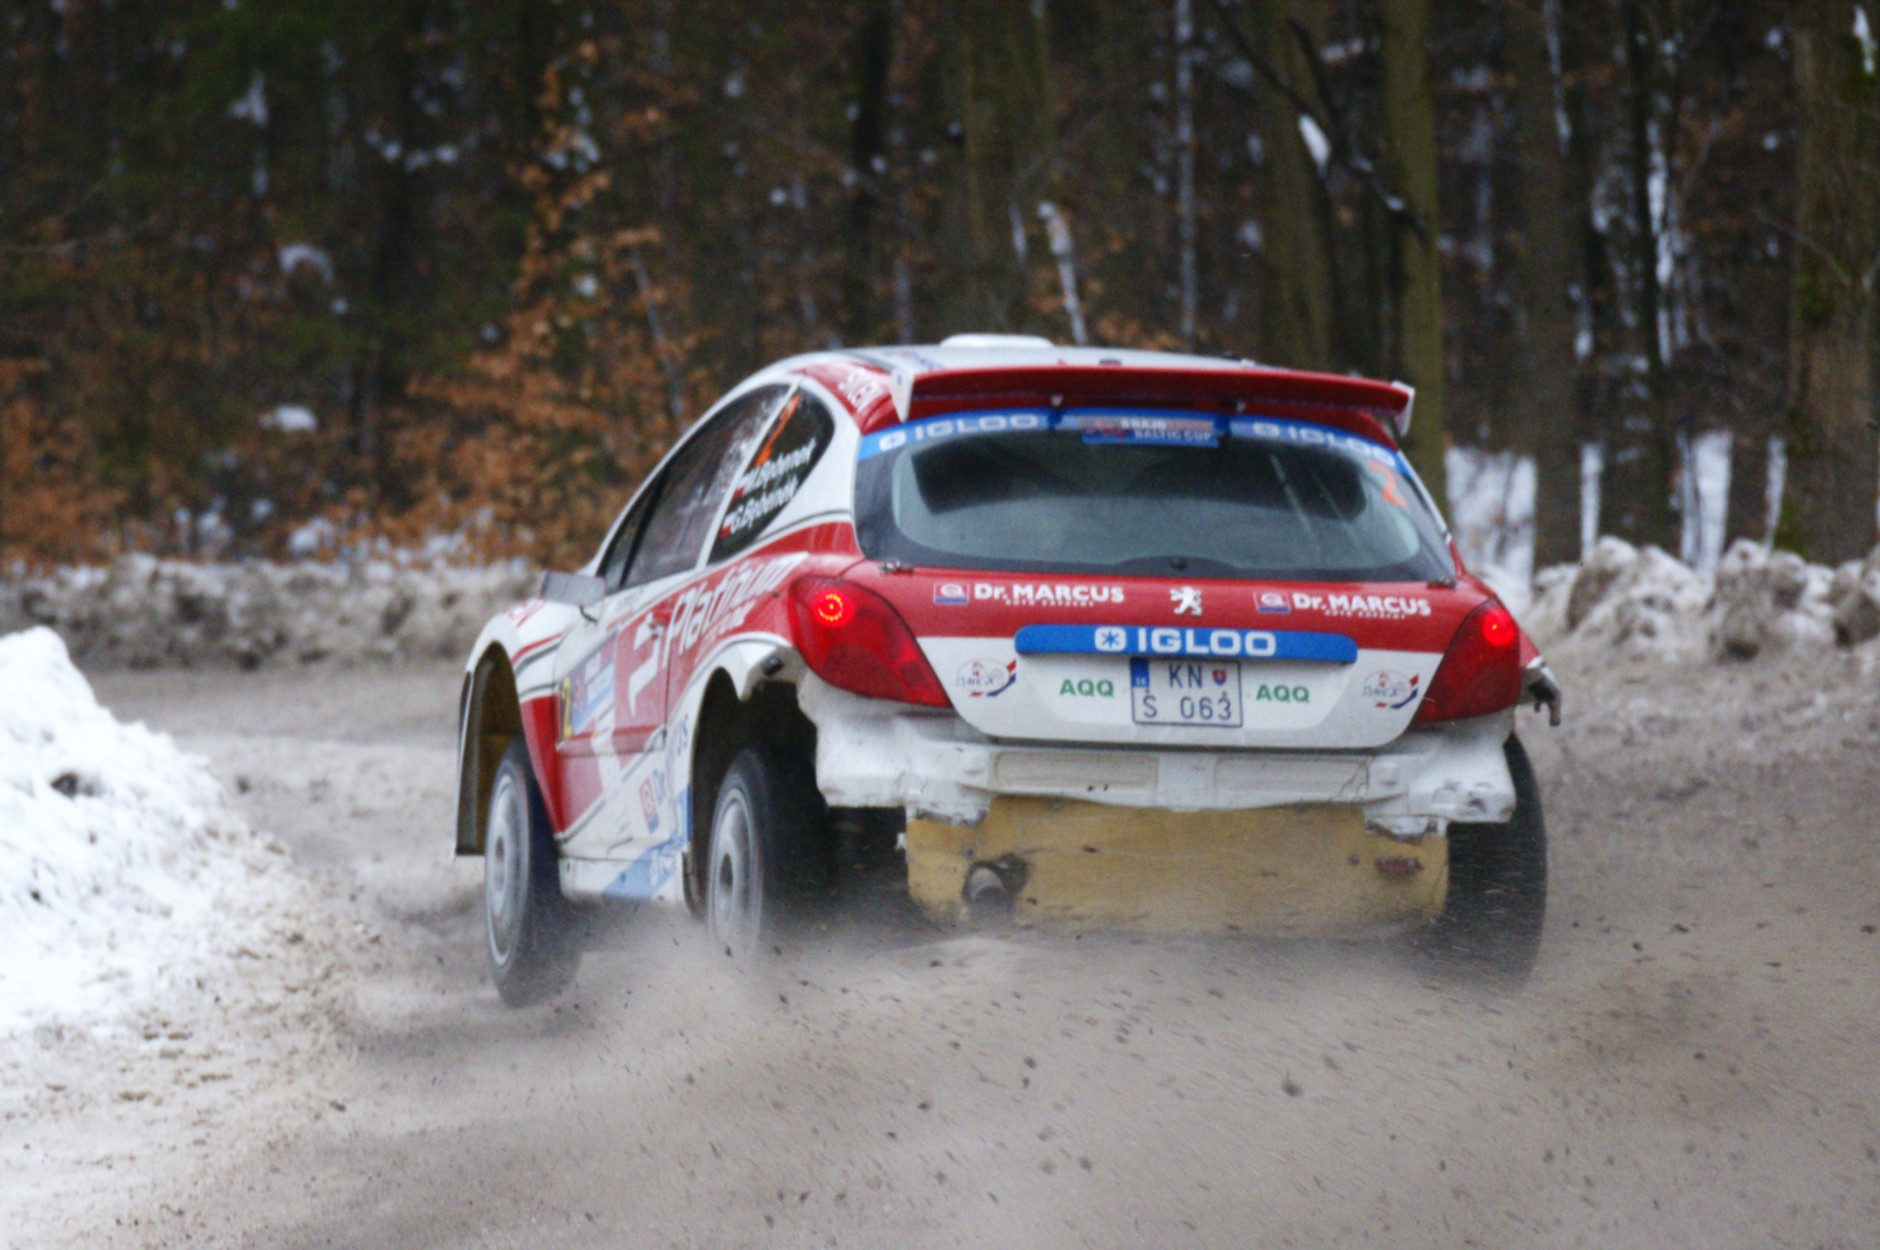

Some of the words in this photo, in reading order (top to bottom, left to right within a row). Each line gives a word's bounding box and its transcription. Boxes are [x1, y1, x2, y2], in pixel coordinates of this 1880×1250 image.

[915, 414, 1039, 441] IGLOO
[1287, 425, 1397, 468] IGLOO
[1137, 627, 1277, 657] IGLOO
[1168, 664, 1203, 688] KN
[1059, 679, 1115, 698] AQQ
[1256, 684, 1310, 703] AQQ
[1180, 696, 1232, 720] 063
